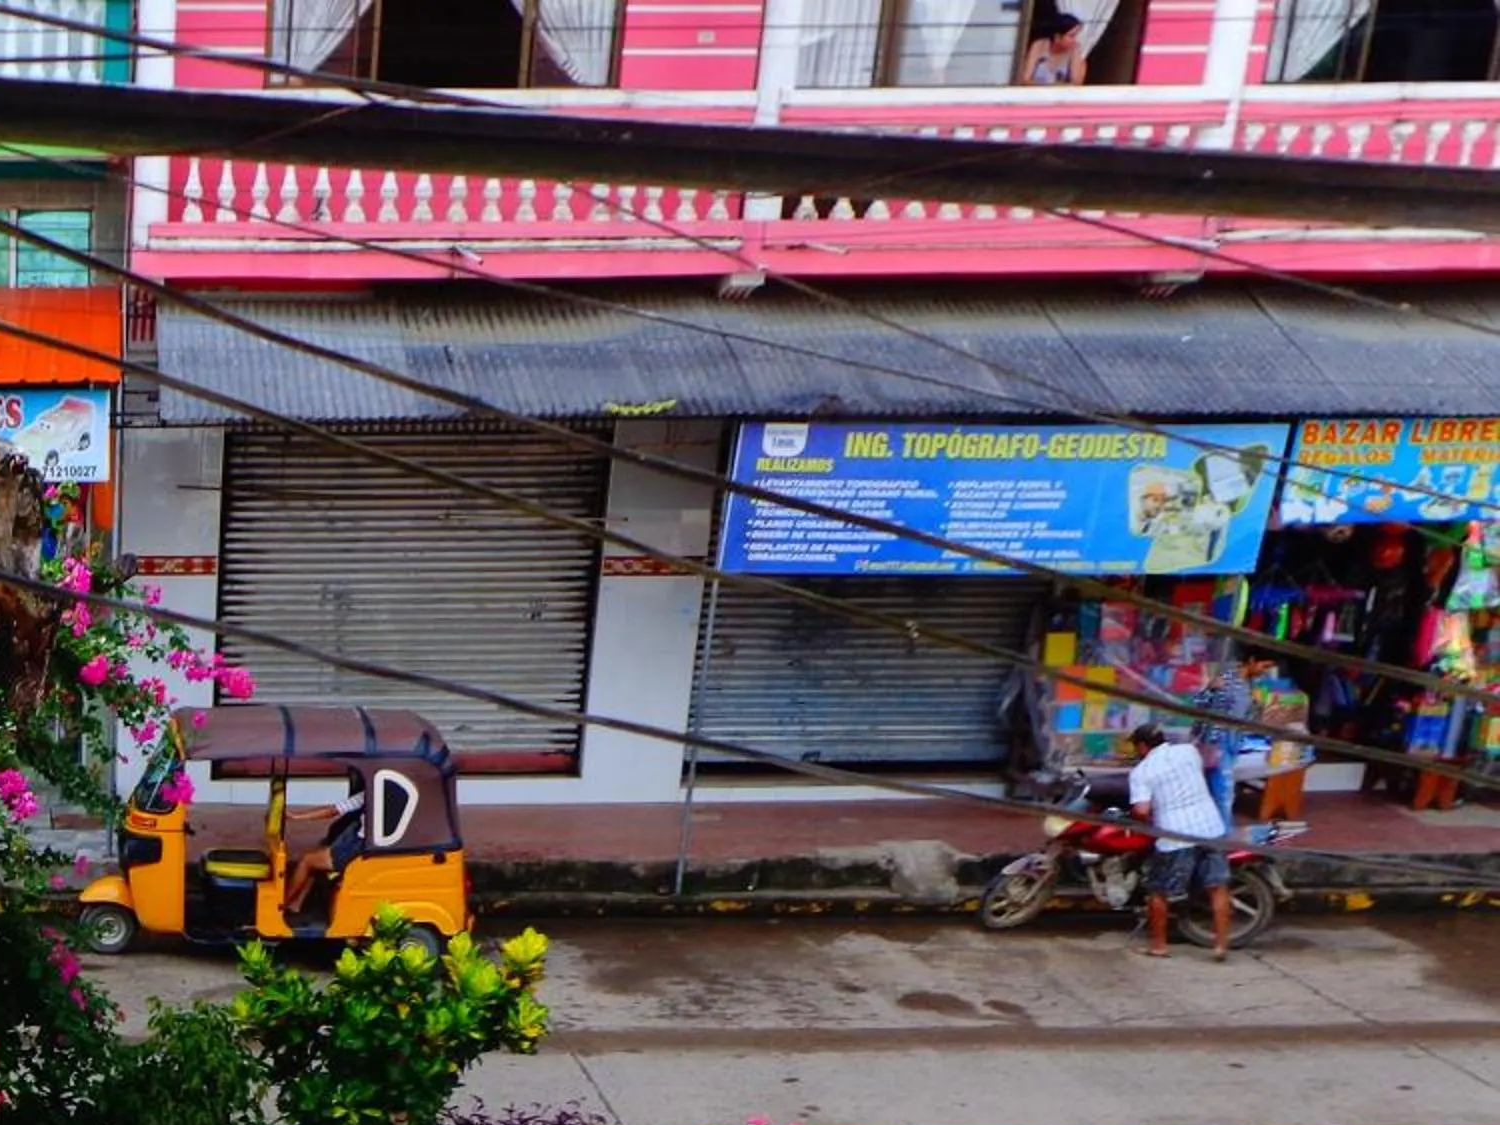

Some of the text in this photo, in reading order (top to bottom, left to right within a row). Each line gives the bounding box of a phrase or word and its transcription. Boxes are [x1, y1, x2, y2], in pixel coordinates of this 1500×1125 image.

[844, 431, 893, 459] ING.
[901, 427, 1167, 460] TOPÓGRAFO-GEODESTA
[1303, 419, 1401, 444] BAZAR
